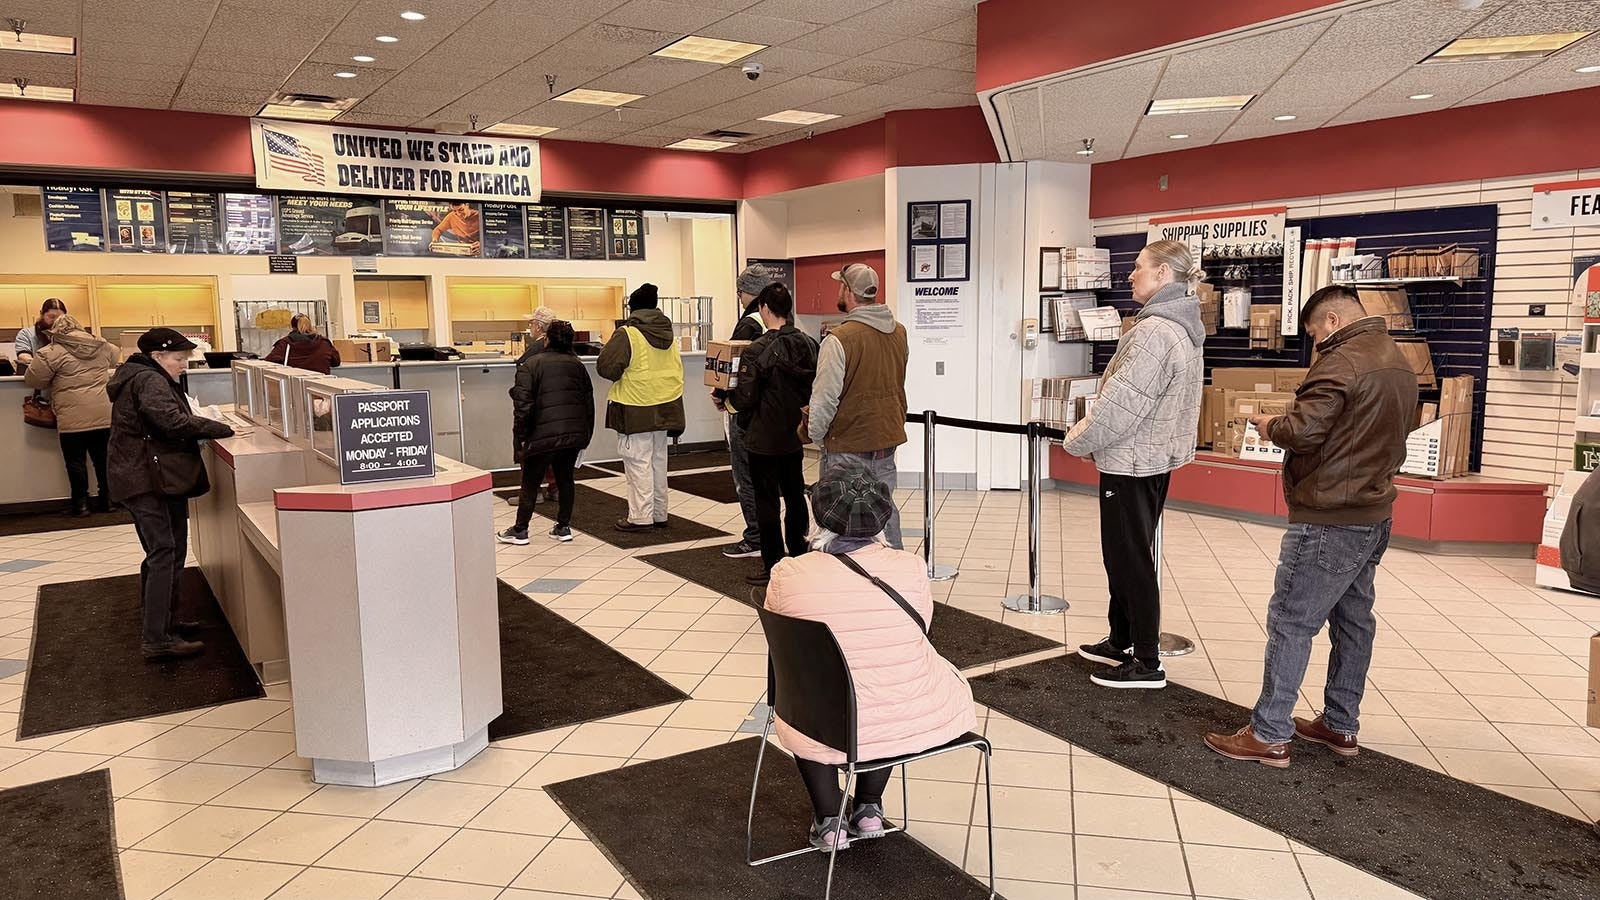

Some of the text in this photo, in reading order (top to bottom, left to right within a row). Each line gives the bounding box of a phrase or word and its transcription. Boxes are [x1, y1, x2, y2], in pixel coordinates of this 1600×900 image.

[332, 133, 531, 168] UNITED WE STAND AND
[338, 164, 532, 197] DELIVER FOR AMERICA
[1570, 194, 1600, 216] FEA
[1162, 219, 1268, 241] SHIPPING SUPPLIES
[915, 286, 960, 297] WELCOME
[358, 400, 410, 413] PASSPORT
[350, 415, 420, 430] APPLICATIONS
[360, 431, 413, 444] ACCEPTED
[346, 448, 387, 461] MONDAY
[396, 445, 428, 457] FRIDAY
[359, 462, 381, 470] 8:00
[396, 459, 418, 467] 4:00
